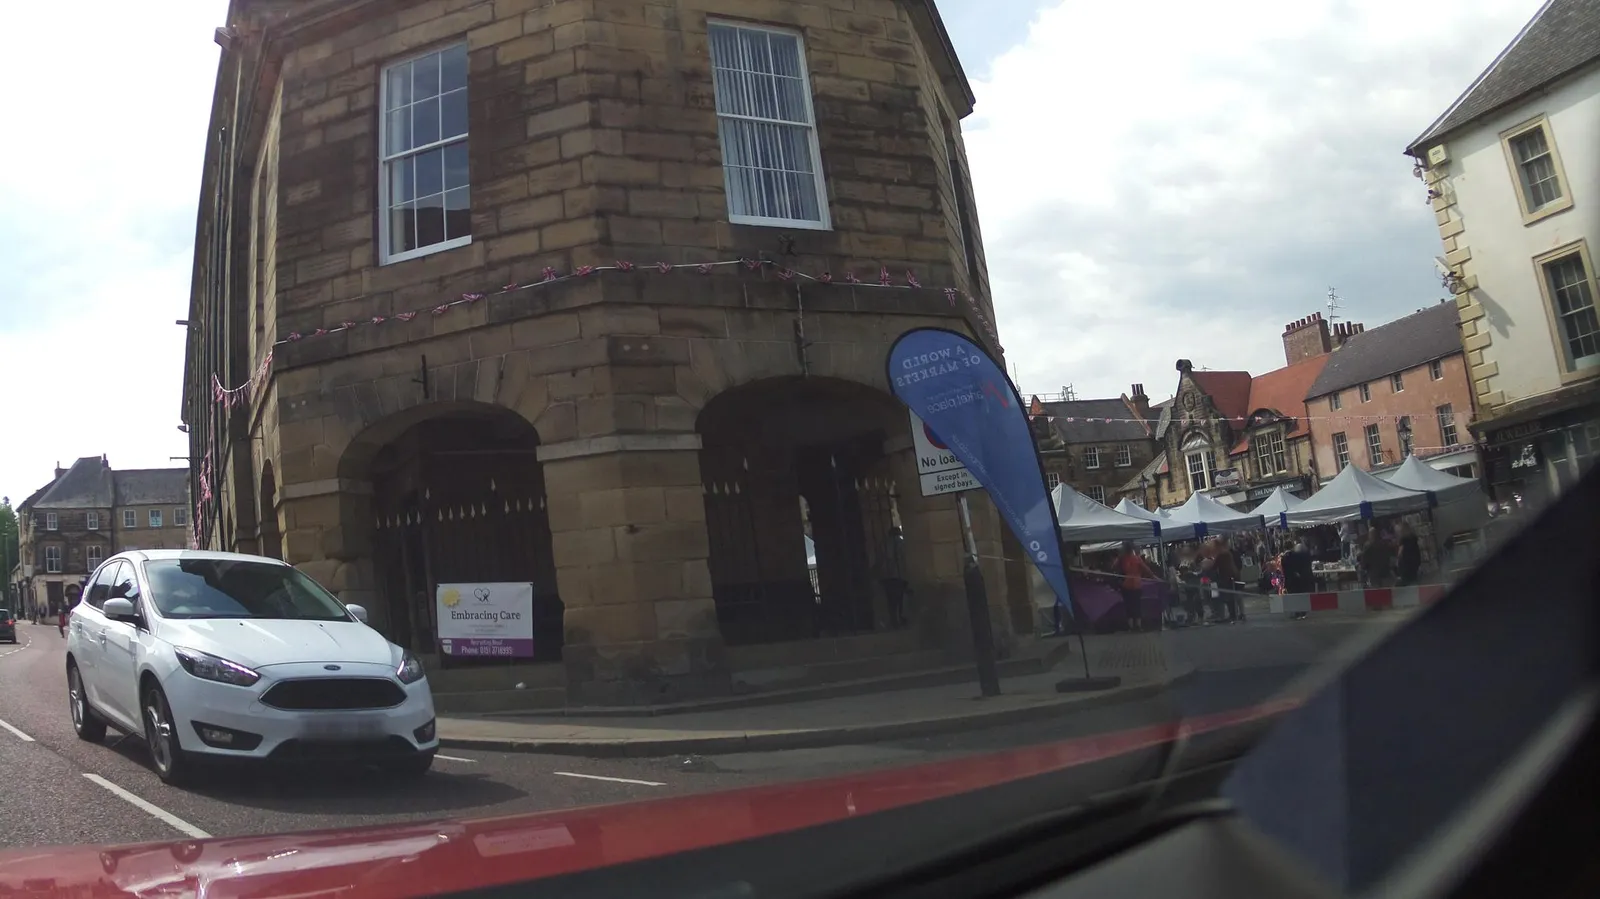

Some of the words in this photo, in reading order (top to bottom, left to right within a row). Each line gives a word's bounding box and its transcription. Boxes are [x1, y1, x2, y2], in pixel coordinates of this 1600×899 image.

[921, 456, 937, 468] No
[938, 454, 961, 465] loa
[937, 472, 960, 482] Except
[934, 482, 956, 491] signed
[957, 479, 973, 488] bays
[451, 609, 499, 623] Embracing
[500, 610, 521, 620] Care
